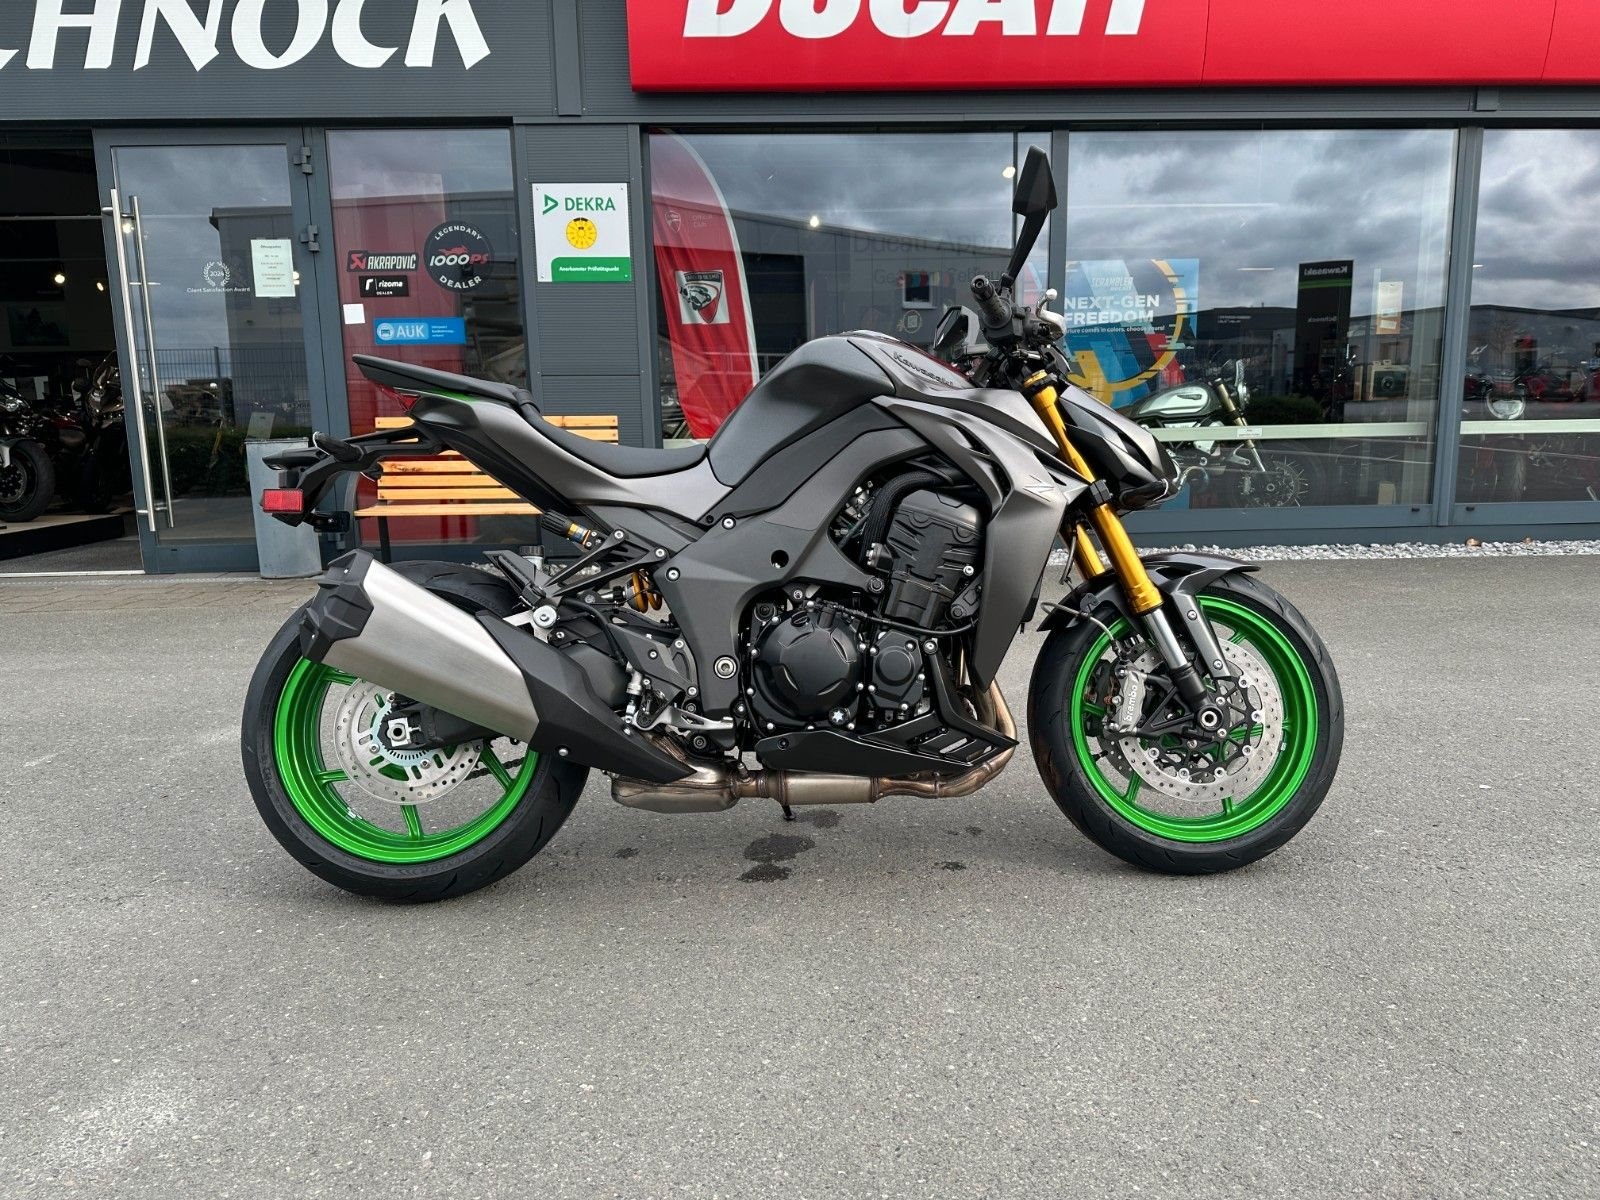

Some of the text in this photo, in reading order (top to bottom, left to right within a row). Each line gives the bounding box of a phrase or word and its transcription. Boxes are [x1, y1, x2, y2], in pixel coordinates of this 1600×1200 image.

[0, 0, 491, 71] HNOCK
[564, 197, 616, 211] DEKRA
[434, 225, 482, 241] LEGENDARY
[430, 254, 488, 266] 1000PS
[378, 280, 403, 288] rizoma
[439, 275, 482, 289] DEALER
[1064, 295, 1159, 309] NEXT-GEN
[1064, 310, 1153, 324] FREEDOM
[1123, 684, 1138, 722] brembo
